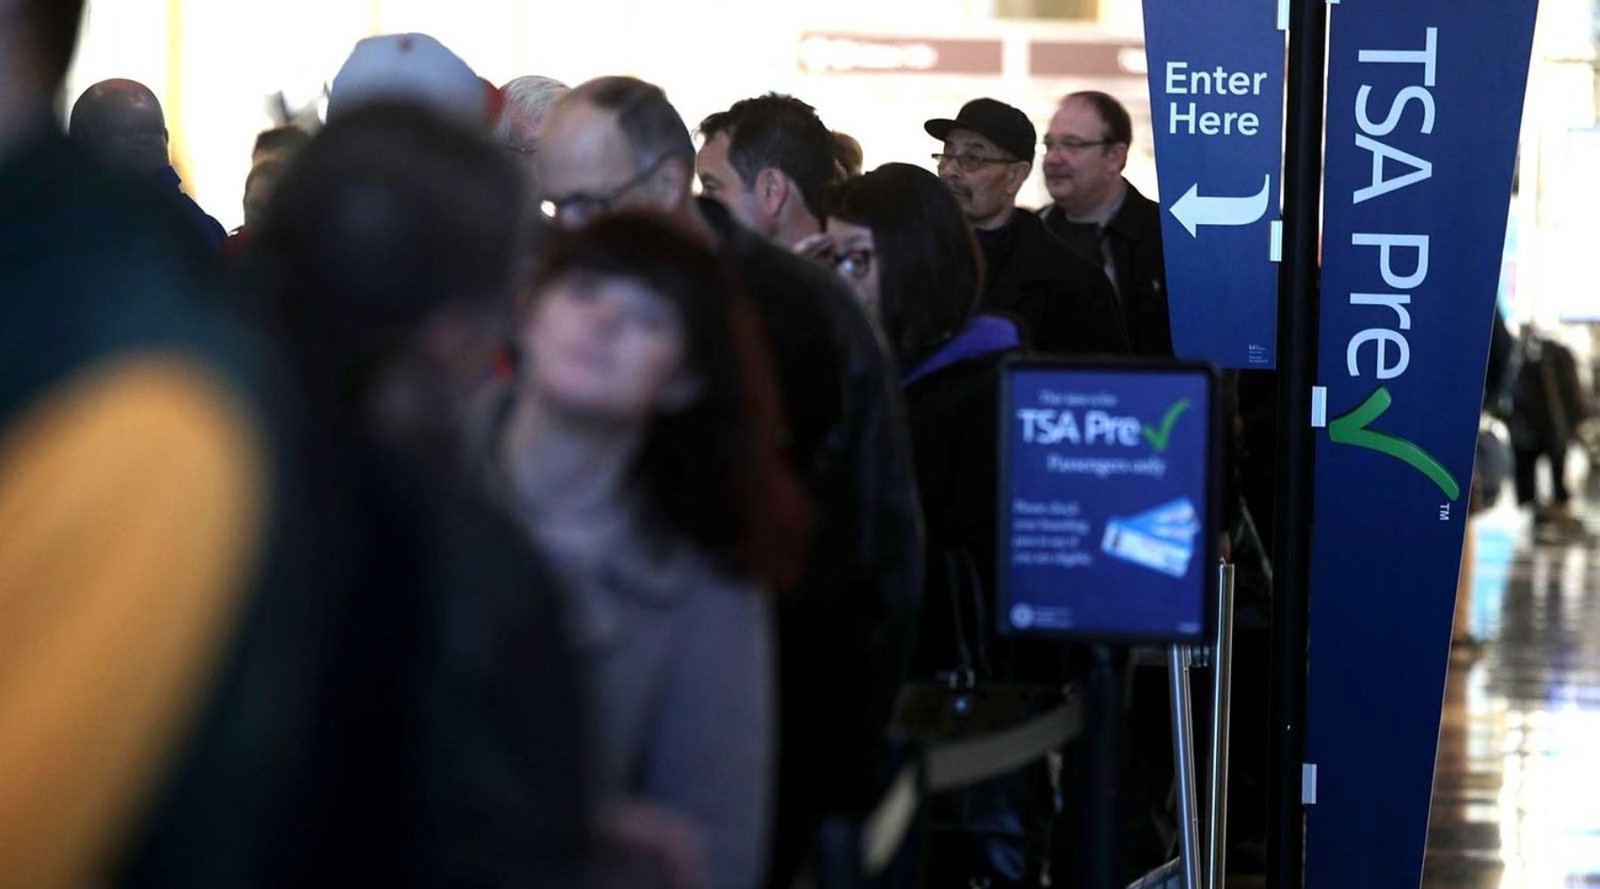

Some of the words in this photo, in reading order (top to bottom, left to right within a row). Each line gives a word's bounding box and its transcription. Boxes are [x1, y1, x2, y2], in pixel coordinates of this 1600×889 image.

[1165, 61, 1268, 96] Enter
[1169, 101, 1260, 136] Here
[1353, 26, 1438, 204] TSA
[1346, 233, 1430, 379] Pre
[1017, 407, 1080, 445] TSA
[1084, 409, 1142, 447] Pre
